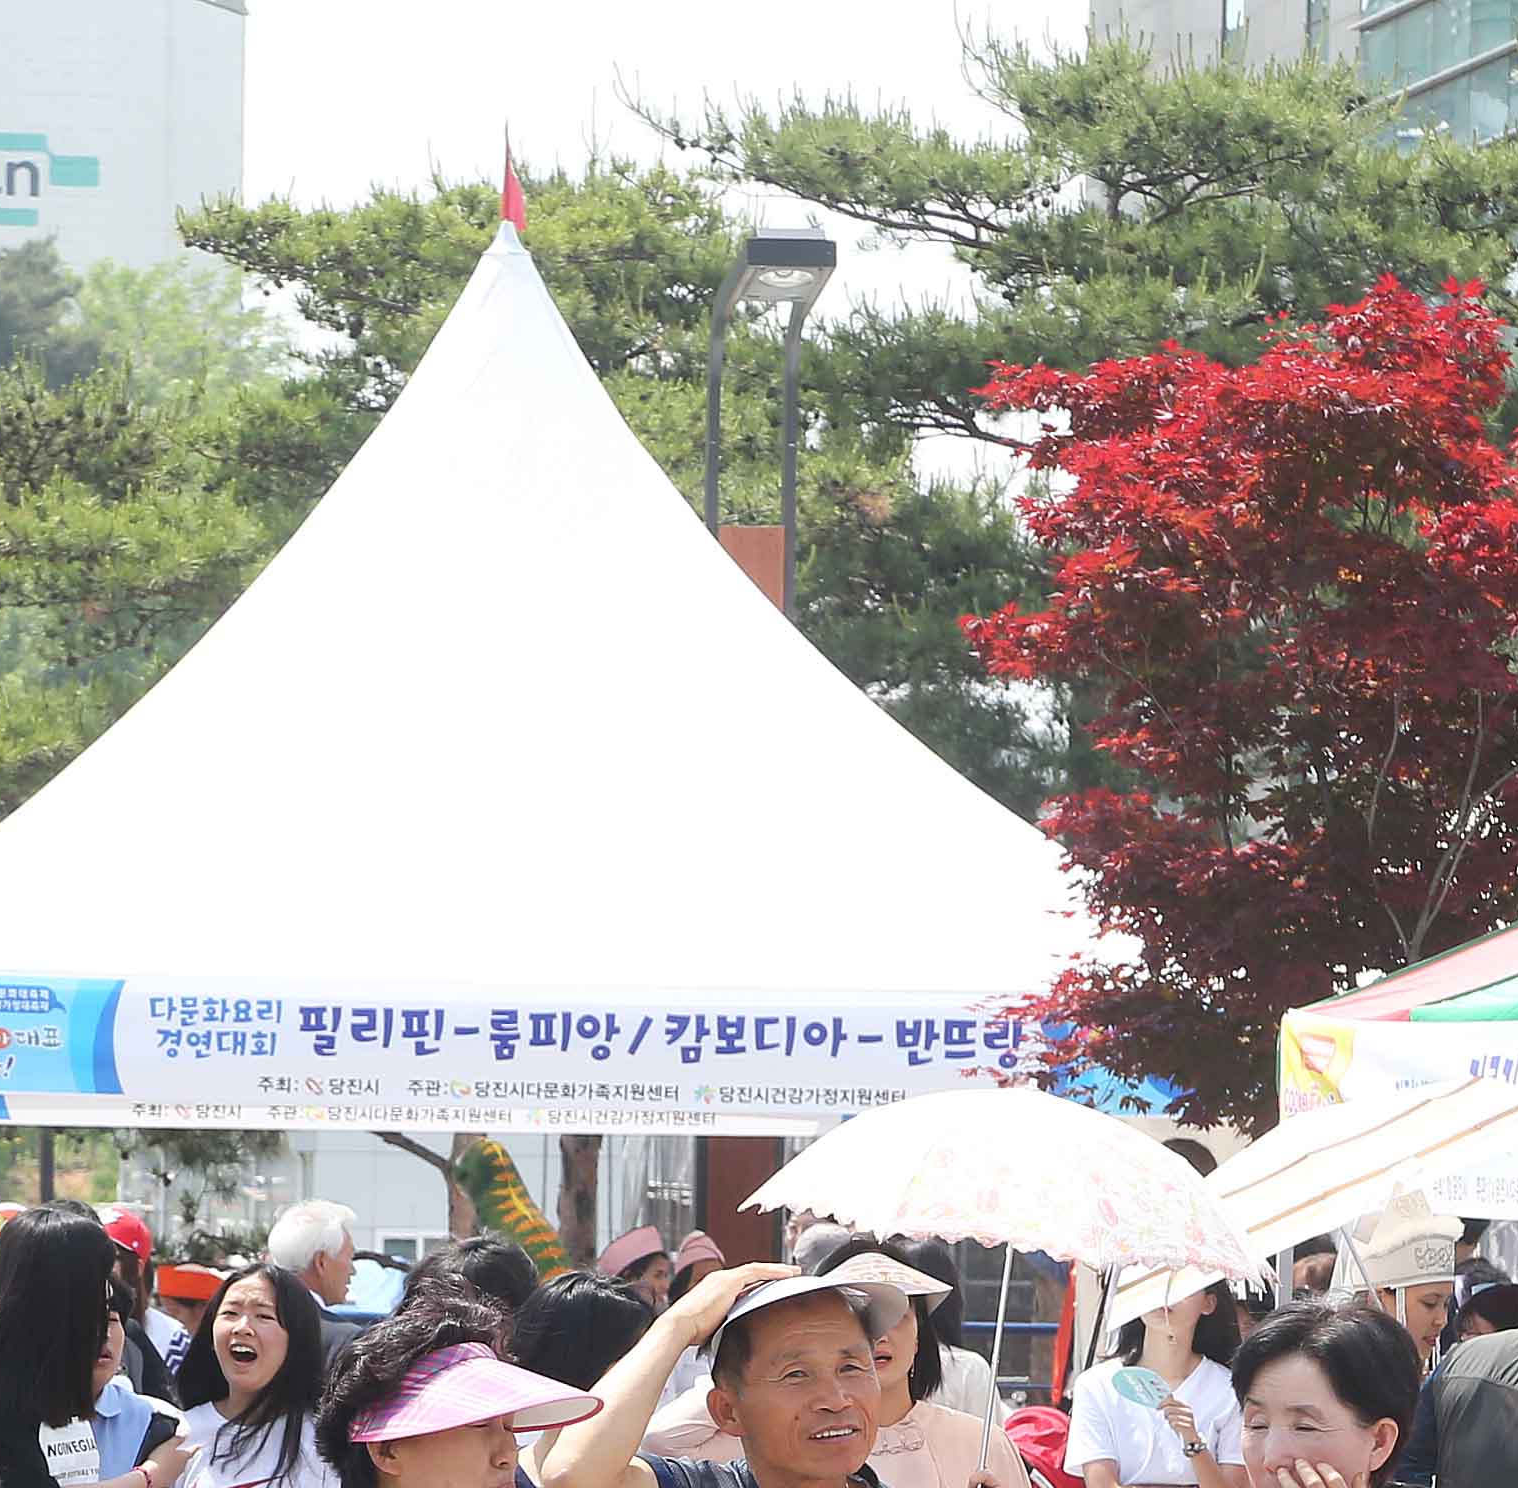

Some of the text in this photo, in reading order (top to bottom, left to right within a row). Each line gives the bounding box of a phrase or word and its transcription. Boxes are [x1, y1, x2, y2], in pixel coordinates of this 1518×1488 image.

[149, 996, 282, 1027] 다문화요리
[157, 1028, 277, 1059] 경연대회
[257, 1076, 906, 1107] 주최: 당진시 주관: 당진시다문화가족지원센터 당진시건강가정지원센터
[195, 1103, 242, 1120] 당진시
[328, 1105, 513, 1124] 당진시다문화가족지원센터
[547, 1107, 717, 1127] 당진시건강가정지원센터
